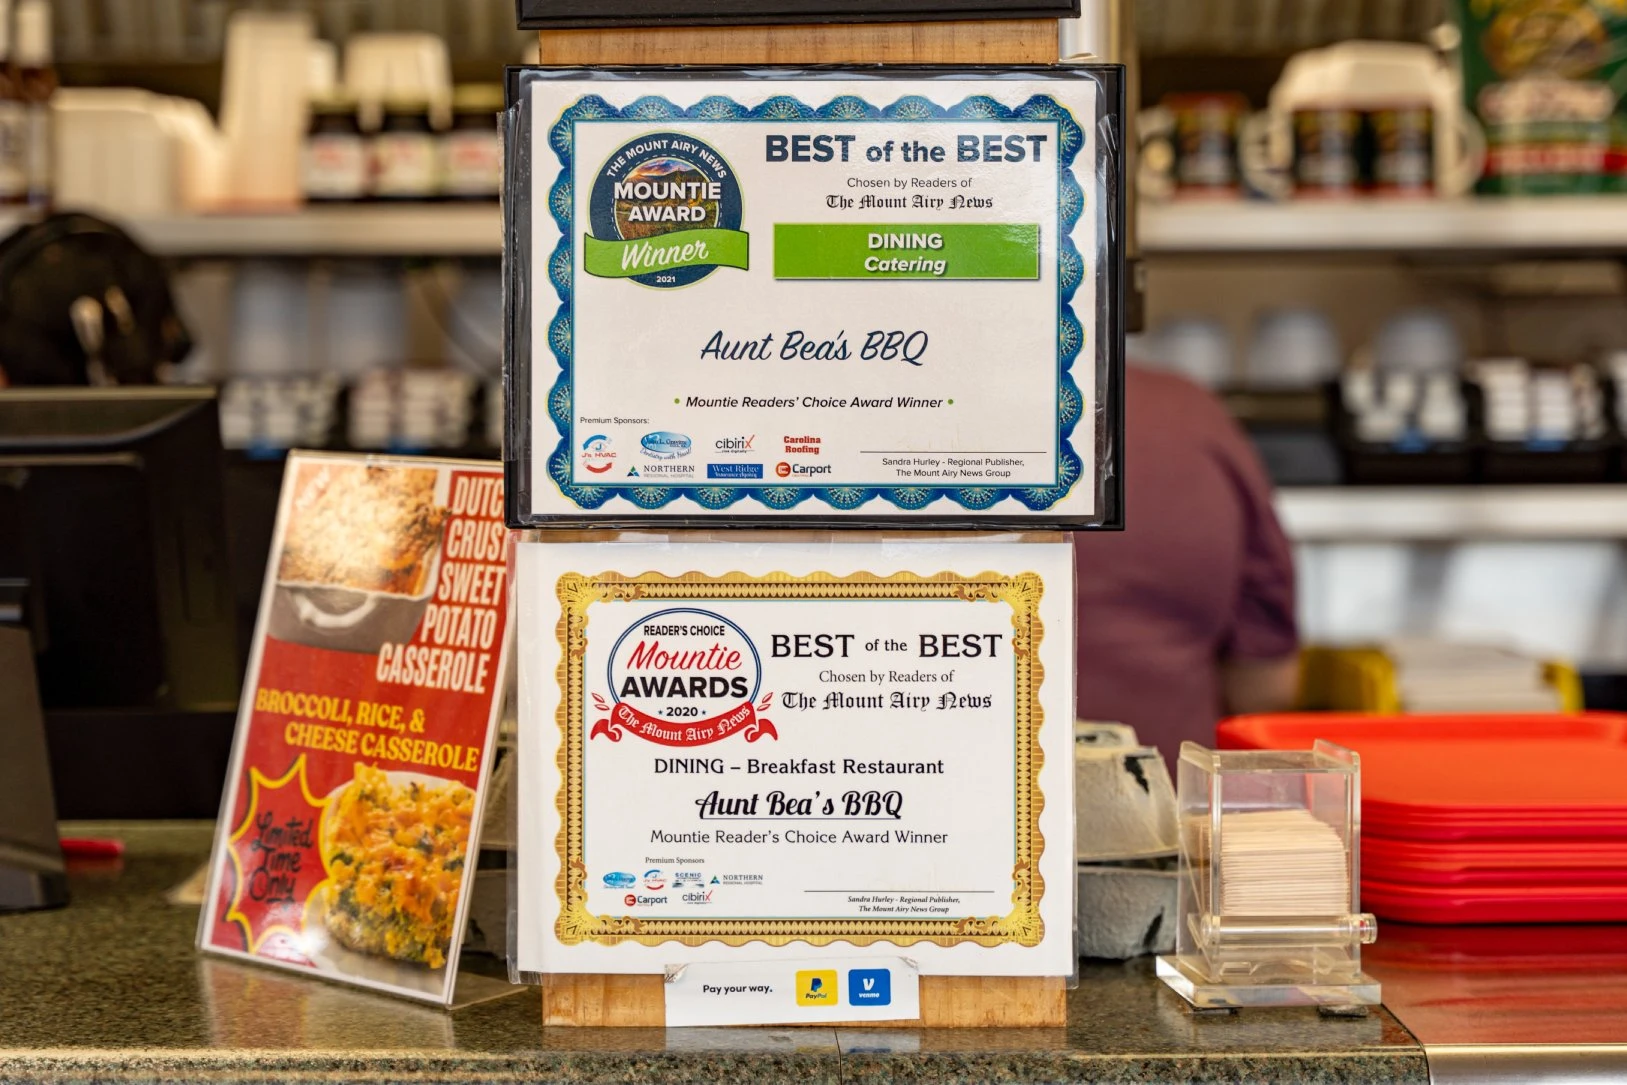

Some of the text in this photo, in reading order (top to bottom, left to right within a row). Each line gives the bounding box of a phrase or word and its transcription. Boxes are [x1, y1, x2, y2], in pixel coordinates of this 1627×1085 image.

[766, 134, 1048, 162] BEST of the BEST
[606, 139, 727, 179] THE MOUNT AIRY NEWS
[614, 182, 722, 200] MOUNTIE
[847, 177, 973, 190] Chosen by Readers of
[826, 194, 993, 210] The Mount Airy News
[628, 206, 706, 222] AWARD
[868, 233, 943, 250] DINING
[621, 240, 710, 271] Winner
[864, 256, 947, 275] Catering
[700, 330, 929, 366] Aunt Bea's BBQ
[686, 397, 943, 409] Mountie Readers' Choice Award Winner
[613, 417, 650, 425] Sponsors:
[785, 446, 819, 455] Roofing
[735, 465, 759, 473] Ridge
[792, 463, 832, 477] Carport
[882, 458, 911, 466] Sandra
[913, 458, 940, 467] Hurley
[948, 458, 983, 467] Regional
[985, 458, 1024, 467] Publisher,
[896, 469, 1011, 478] The Mount Airy News Group
[452, 476, 504, 517] DUTC
[437, 562, 506, 606] SWEET
[420, 604, 497, 650] POTATO
[643, 625, 725, 636] READER'S CHOICE
[771, 634, 1003, 658] BEST of the BEST
[627, 640, 743, 670] Mountie
[376, 642, 491, 695] CASSEROLE
[819, 670, 955, 685] Chosen by Readers of
[619, 676, 749, 698] AWARDS
[781, 691, 992, 711] The Mount Airy News
[255, 687, 426, 734] BROCCOLI, RICE, &
[666, 707, 698, 717] 2020
[618, 705, 750, 742] The Mount Airy News
[284, 722, 480, 773] CHEESE CASSEROLE
[654, 758, 725, 774] DINING
[747, 758, 836, 774] Breakfast
[843, 758, 944, 774] Restaurant
[695, 790, 904, 819] Aunt Bea's BBQ
[650, 830, 948, 844] Mountie Reader's Choice Award Winner
[260, 845, 302, 873] Time
[645, 856, 705, 865] Premium Sponsors
[249, 866, 296, 905] Only
[637, 895, 668, 907] Carport
[872, 896, 894, 904] Hurley
[900, 896, 928, 904] Regional
[929, 896, 961, 905] Publisher,
[858, 905, 871, 913] The
[895, 906, 909, 914] Airy
[929, 906, 950, 914] Group
[703, 983, 773, 996] Pay your way.
